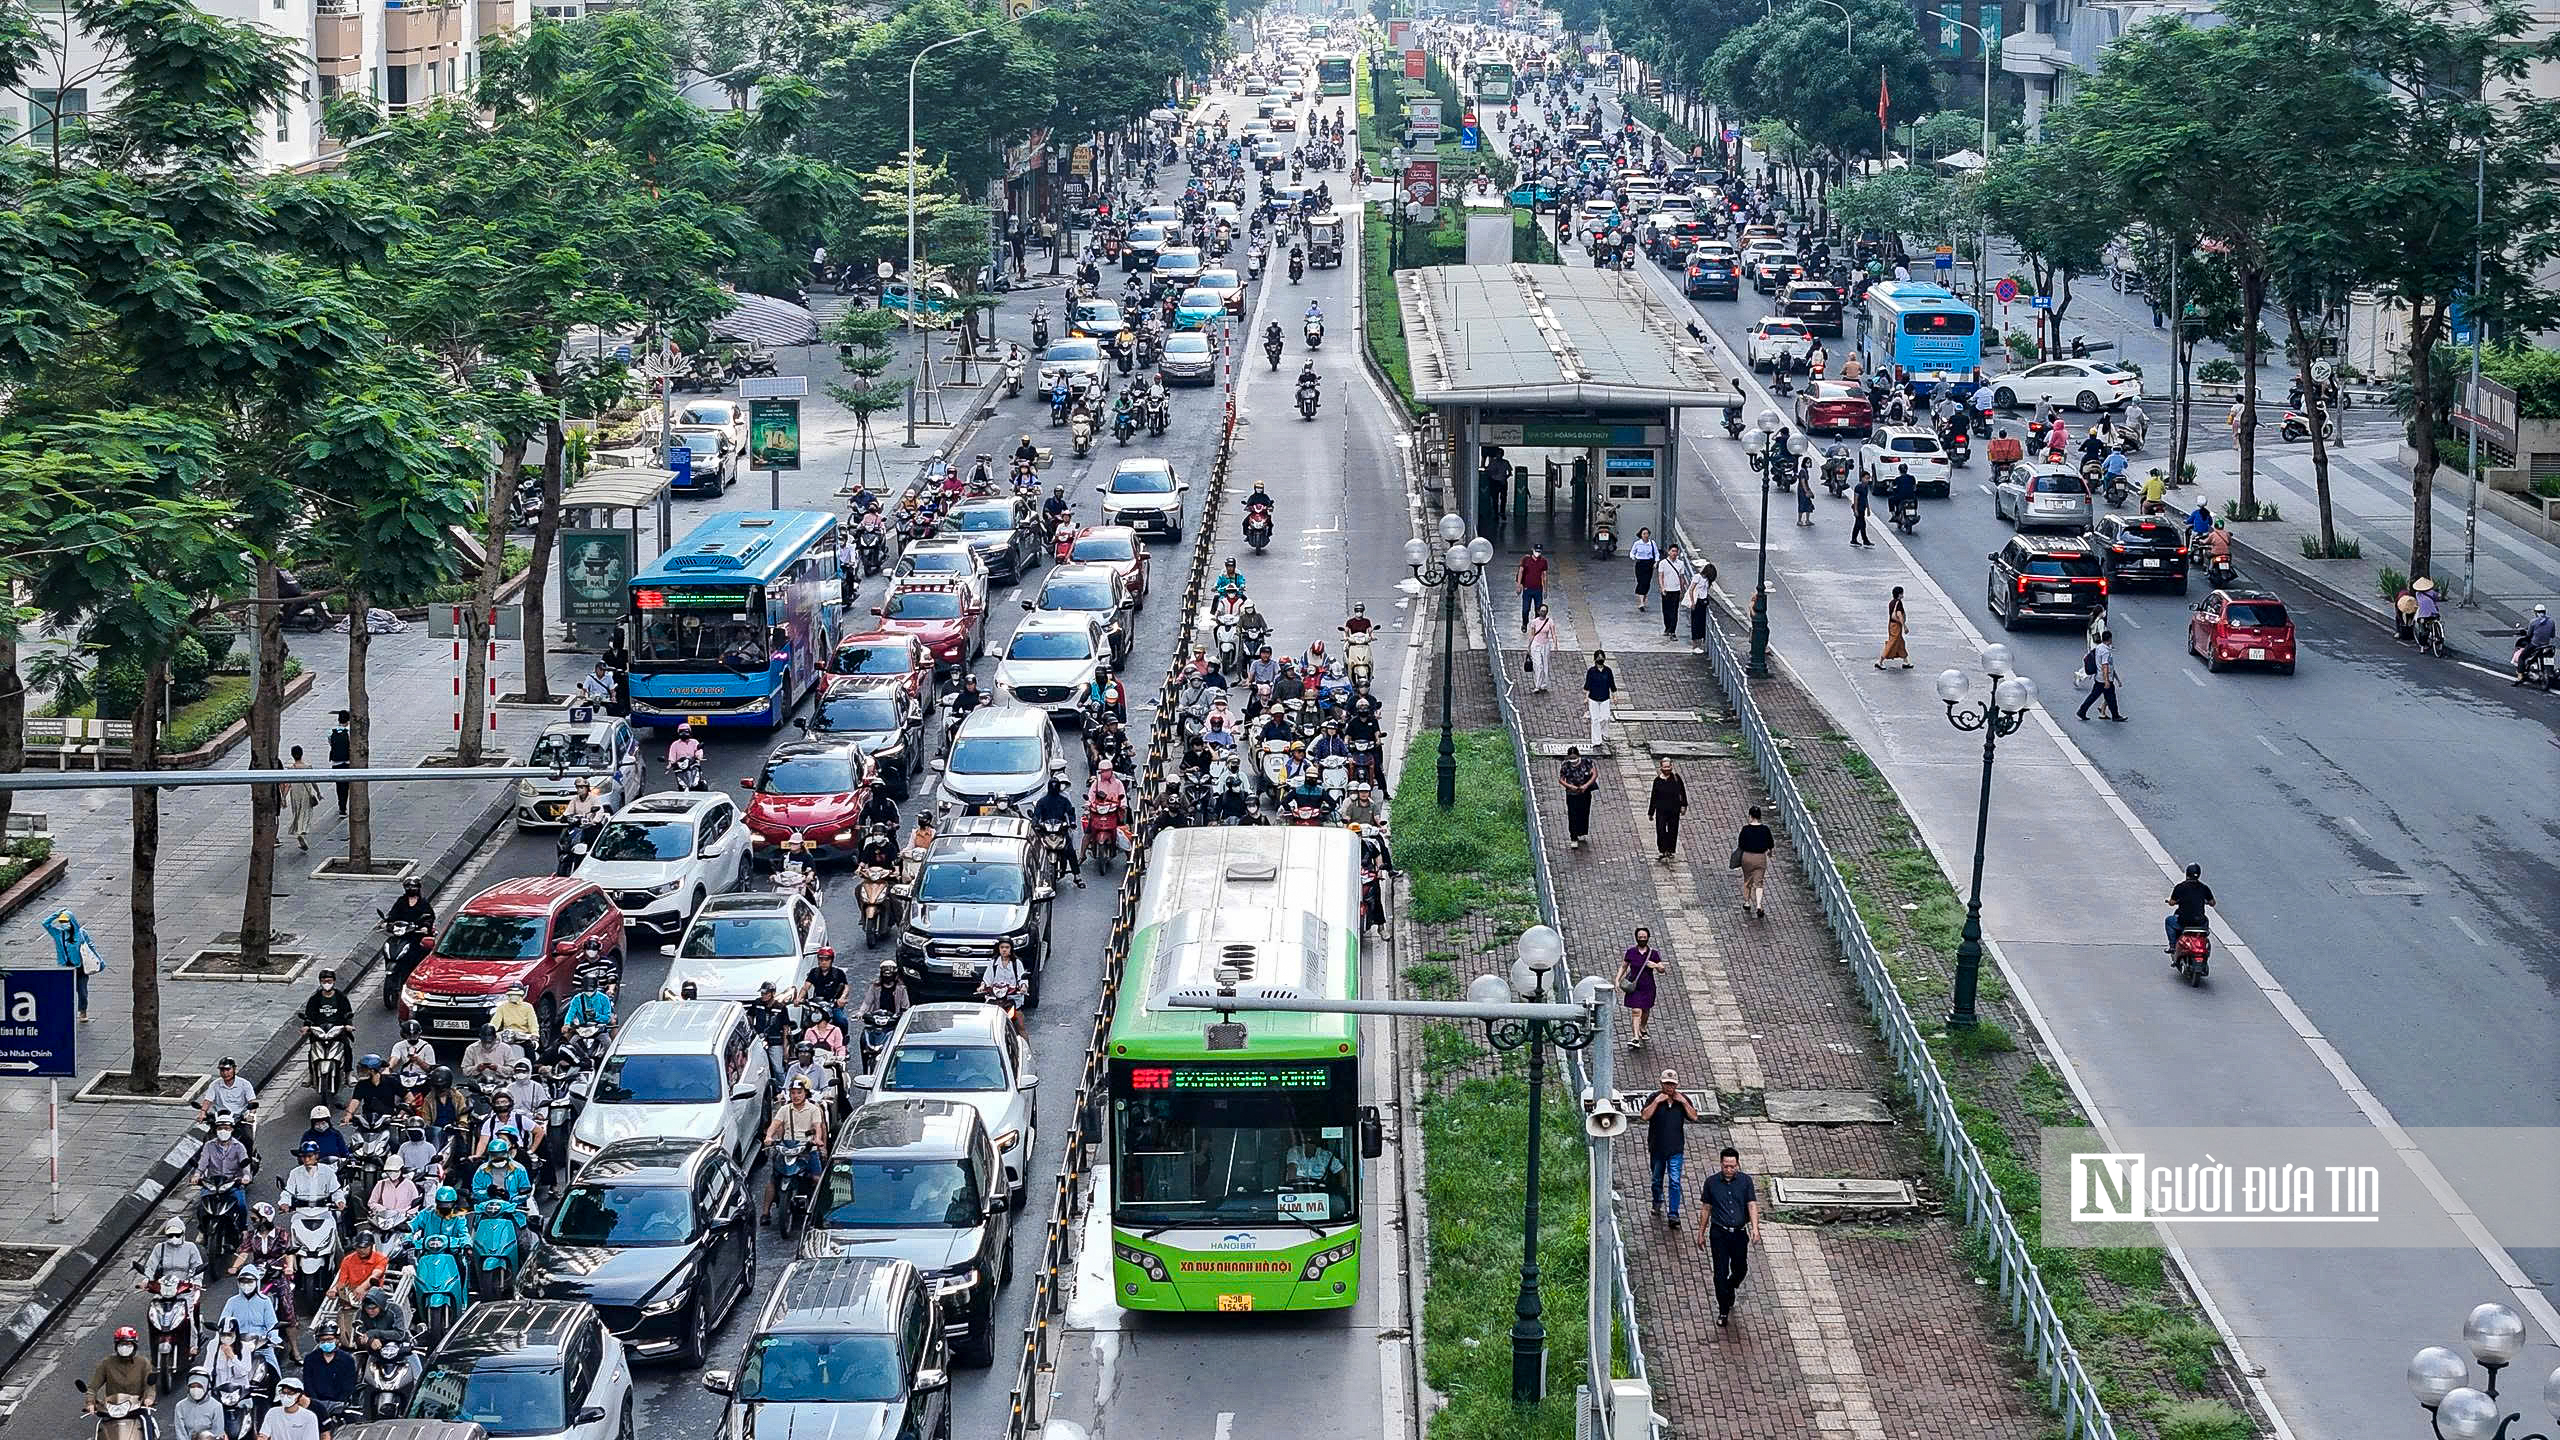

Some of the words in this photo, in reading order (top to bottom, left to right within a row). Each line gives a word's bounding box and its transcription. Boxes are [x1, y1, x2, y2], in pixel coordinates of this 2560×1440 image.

[15, 1026, 25, 1036] for
[27, 1026, 38, 1036] life
[31, 1049, 53, 1057] Chính
[1132, 1068, 1172, 1089] BRT
[1279, 1203, 1301, 1212] KIM
[1306, 1200, 1325, 1212] MÃ
[1180, 1261, 1194, 1272] XN
[1195, 1262, 1215, 1272] BUS
[1216, 1262, 1253, 1272] NHANH
[1255, 1259, 1270, 1272] HÀ
[1271, 1260, 1292, 1274] NỘI
